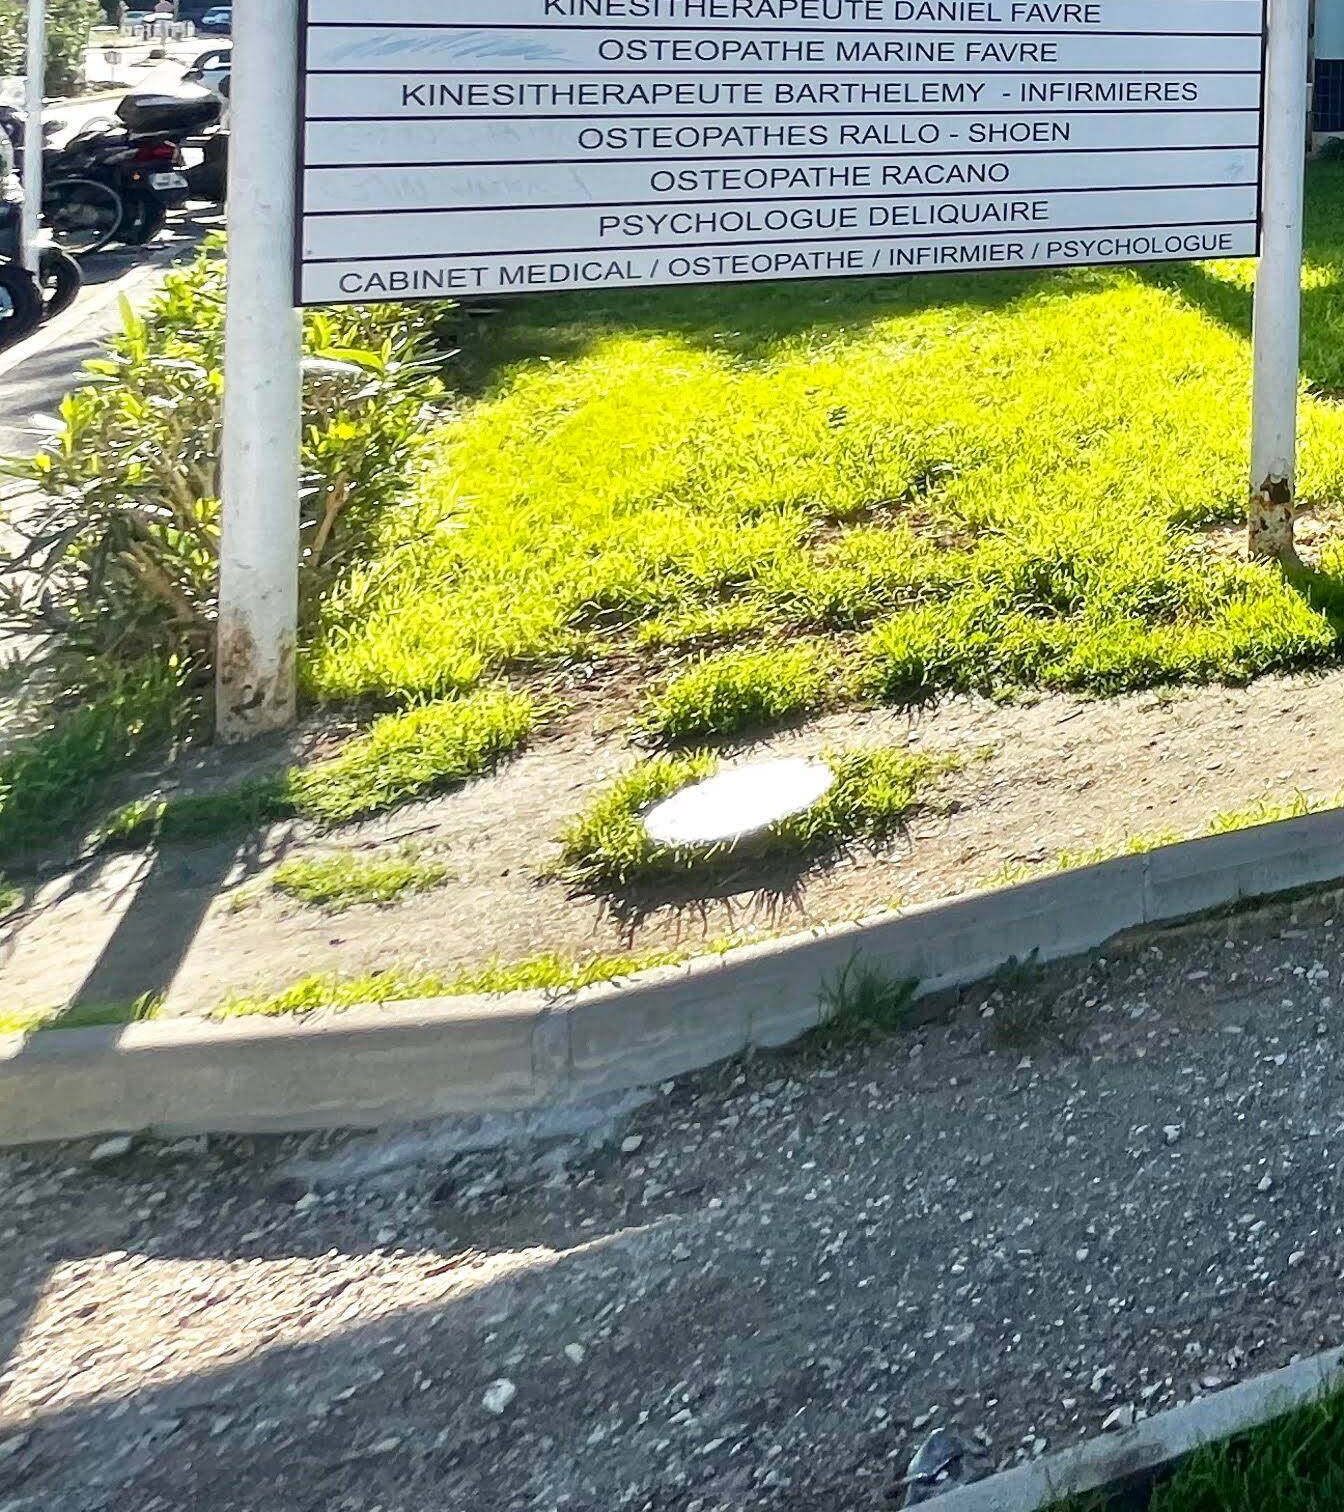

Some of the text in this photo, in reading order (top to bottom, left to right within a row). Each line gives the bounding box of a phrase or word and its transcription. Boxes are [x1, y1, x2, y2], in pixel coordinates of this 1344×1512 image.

[895, 0, 1002, 22] DANIEL
[1011, 3, 1100, 23] FAVRE
[598, 39, 1057, 62] OSTEOPATHE MARINE FAVRE
[402, 82, 1197, 106] KINESITHERAPEUTE BARTHELEMY INFIRMIERES
[578, 125, 828, 149] OSTEOPATHES
[840, 123, 939, 145] RALLO
[968, 122, 1069, 142] SHOEN
[650, 162, 1009, 191] OSTEOPATHE RACANO
[599, 200, 1049, 237] PSYCHOLOGUE DELIQUAIRE
[339, 233, 1232, 293] CABINET MEDICAL OSTEOPATHE INFIRMIER PSYCHOLOGUE
